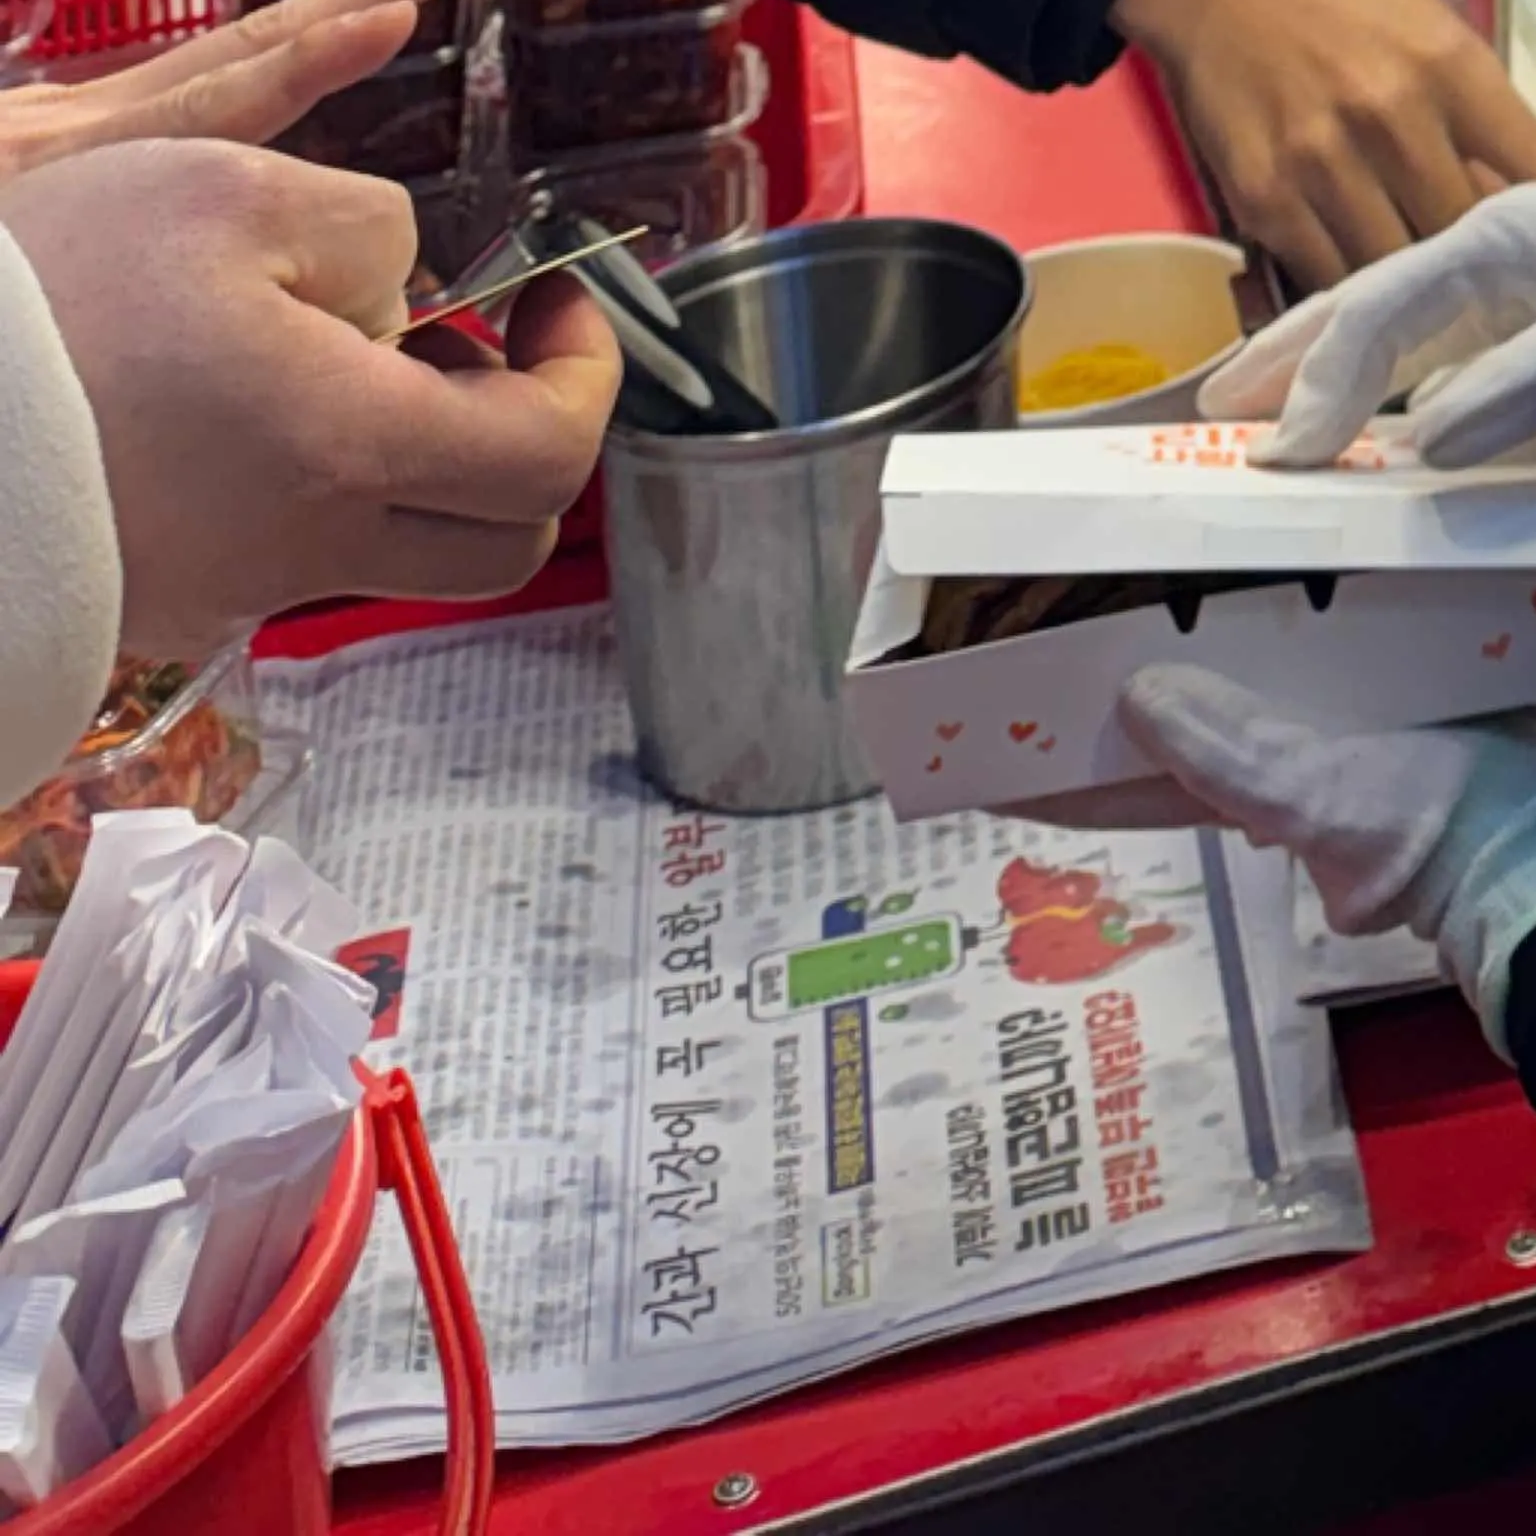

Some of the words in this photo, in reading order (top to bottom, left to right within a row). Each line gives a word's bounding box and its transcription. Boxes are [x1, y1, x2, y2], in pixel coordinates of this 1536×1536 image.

[661, 816, 729, 889] 알부
[655, 902, 726, 1018] 필요한
[656, 1038, 722, 1079] 꼭
[998, 1008, 1083, 1208] 피곤합니까?
[648, 1097, 724, 1223] 신장에
[1014, 1202, 1090, 1252] 늘
[642, 1246, 719, 1337] 간과
